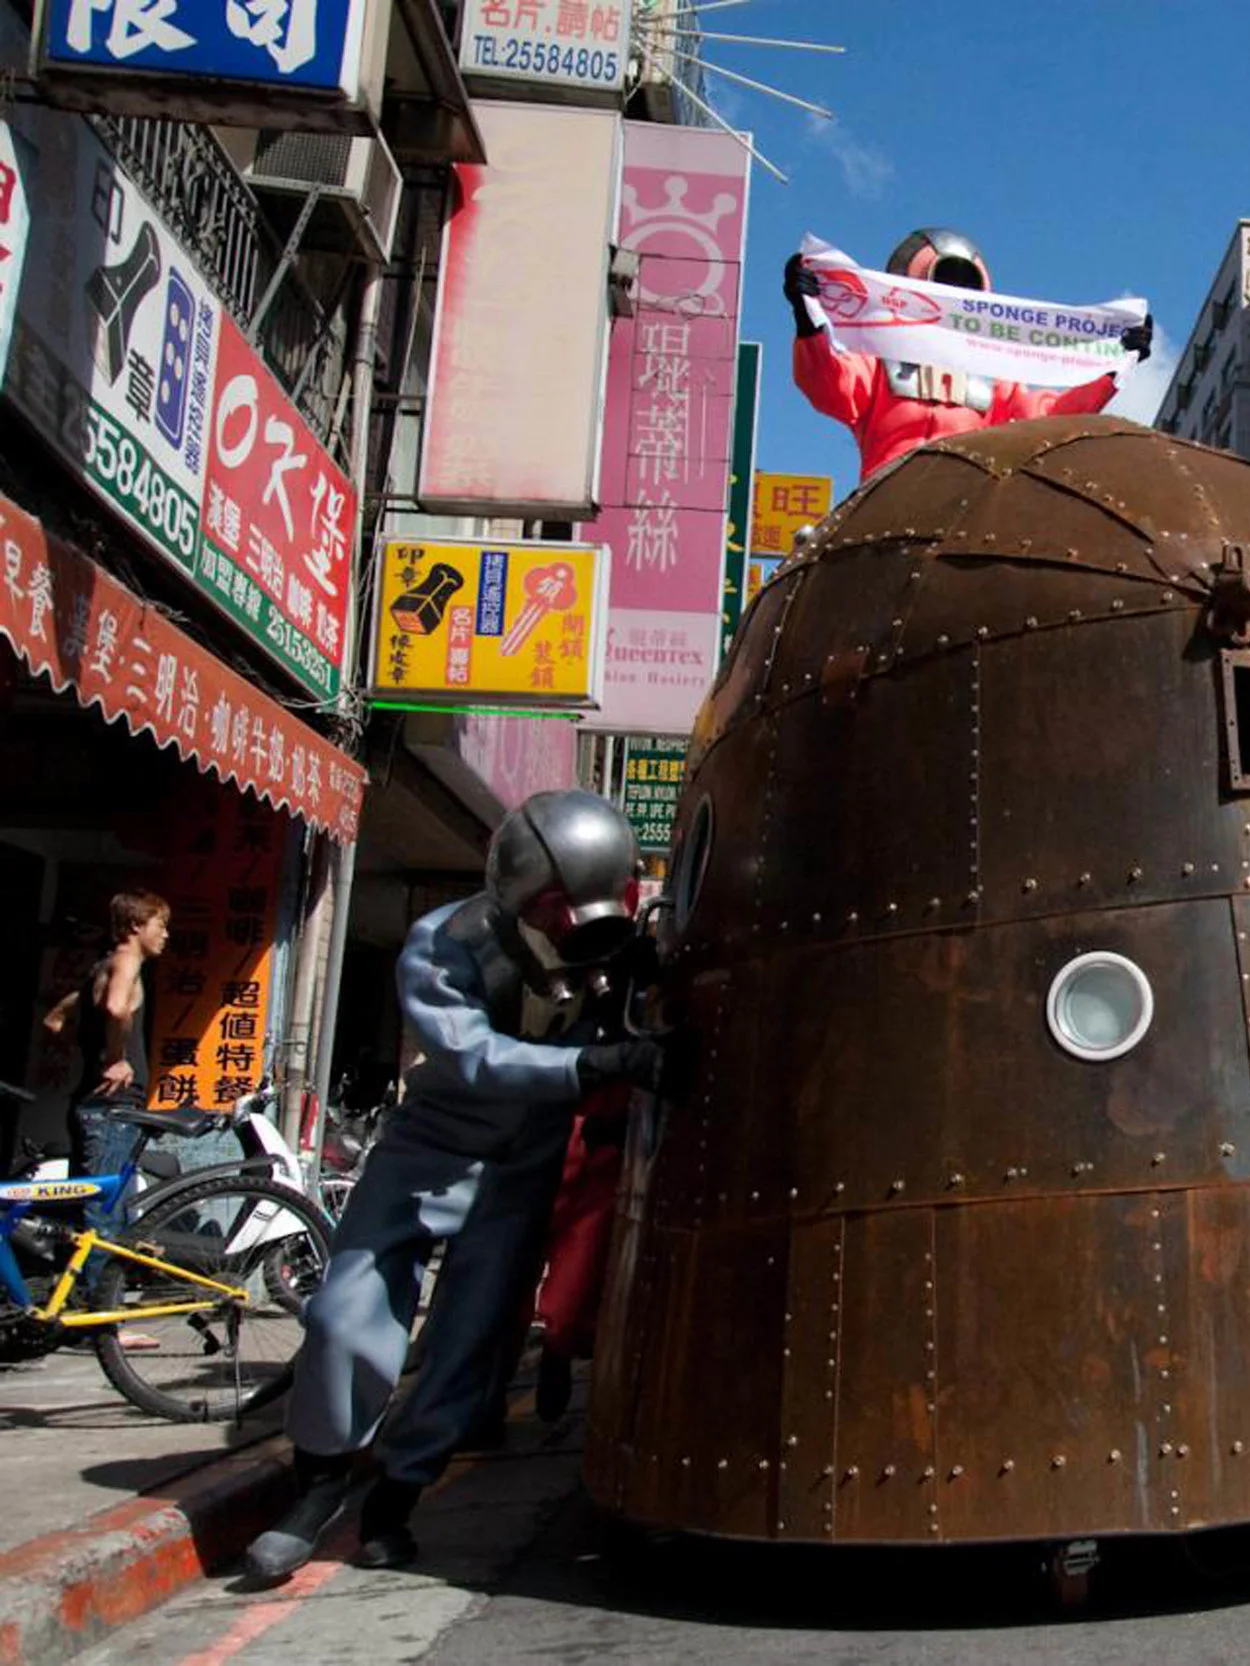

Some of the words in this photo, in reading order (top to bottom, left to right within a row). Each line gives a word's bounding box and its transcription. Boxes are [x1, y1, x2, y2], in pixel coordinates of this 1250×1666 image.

[962, 299, 1049, 326] SPONGE
[949, 313, 981, 334] TO
[990, 321, 1021, 342] BE
[1029, 329, 1125, 358] CONTIN
[126, 636, 198, 737] 三明治
[38, 1186, 87, 1196] KING
